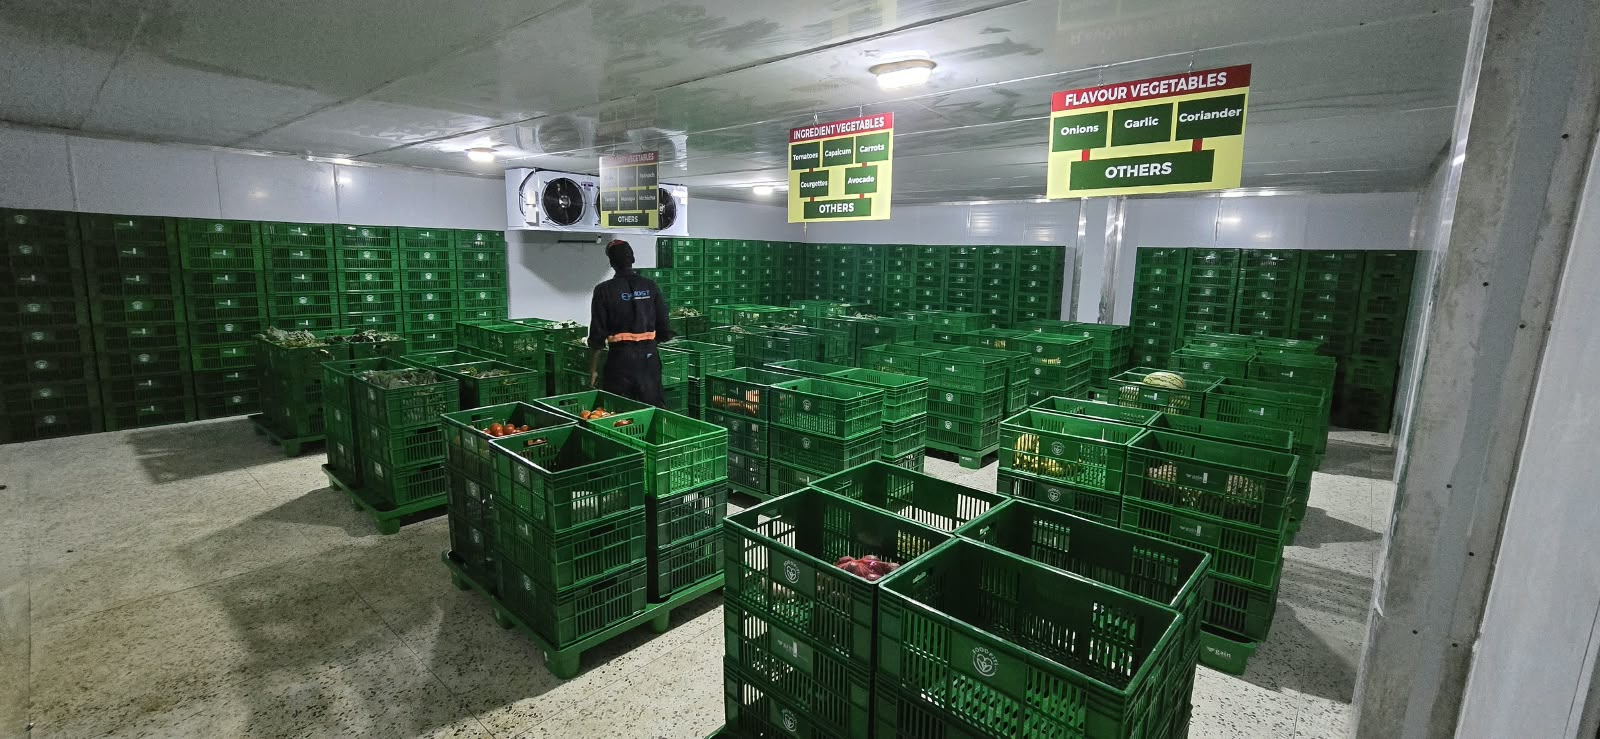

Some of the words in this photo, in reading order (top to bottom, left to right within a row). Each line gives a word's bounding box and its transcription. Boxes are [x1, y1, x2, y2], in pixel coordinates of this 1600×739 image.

[1065, 87, 1127, 107] FLAVOUR
[1130, 71, 1227, 98] VEGETABLES
[1178, 107, 1242, 123] Coriander
[793, 125, 835, 140] INGREDIENT
[836, 116, 885, 133] VEGETABLES
[1124, 116, 1159, 129] Garlic
[1060, 123, 1099, 136] Onions
[859, 143, 885, 153] Carrots
[792, 152, 818, 161] Tomatoes
[1105, 161, 1173, 179] OTHERS
[847, 175, 874, 184] Avocado
[818, 202, 855, 214] OTHERS
[617, 215, 639, 223] OTHERS
